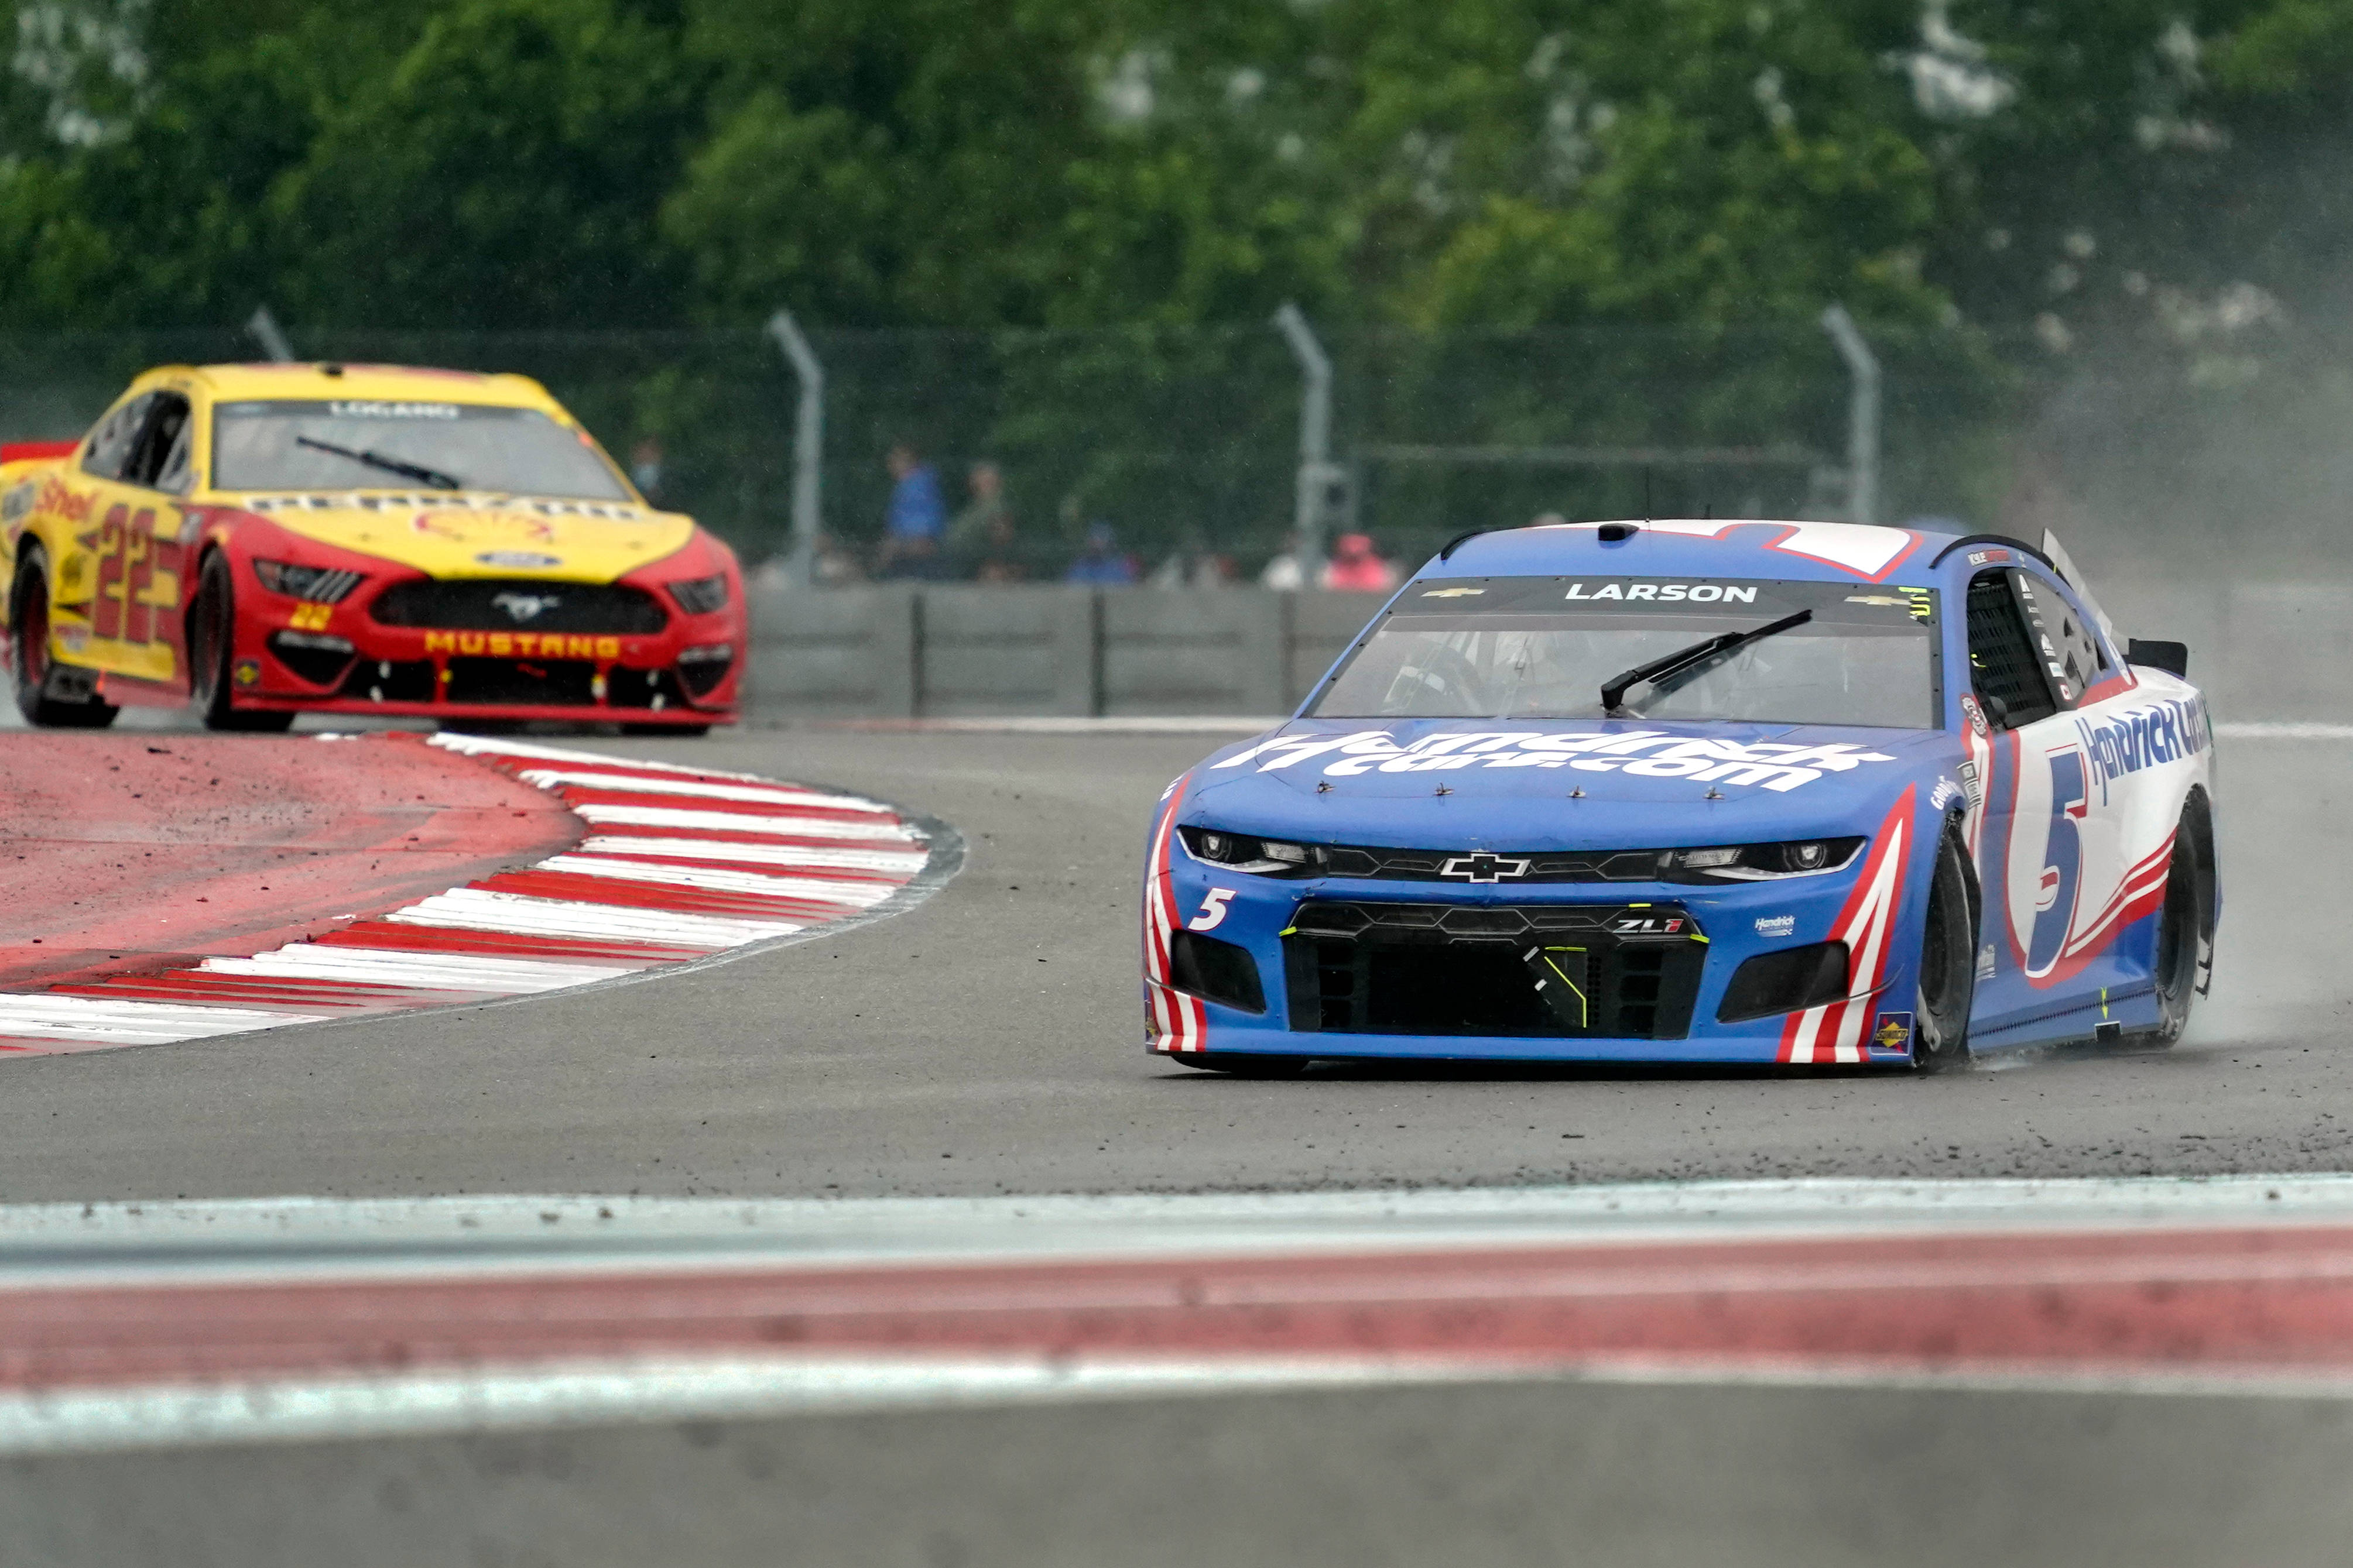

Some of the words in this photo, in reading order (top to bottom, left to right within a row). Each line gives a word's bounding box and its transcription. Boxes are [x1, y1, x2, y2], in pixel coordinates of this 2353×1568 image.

[93, 502, 156, 644] 22
[1565, 584, 1757, 603] LARSON
[289, 602, 333, 631] 22
[424, 630, 619, 660] MUSTANG
[1210, 730, 1898, 772] Hendrick
[1323, 752, 1823, 792] cars.com
[2025, 742, 2088, 978] 5
[1187, 887, 1238, 932] 5
[1612, 918, 1684, 934] ZL1
[1755, 915, 1796, 931] Hendrick
